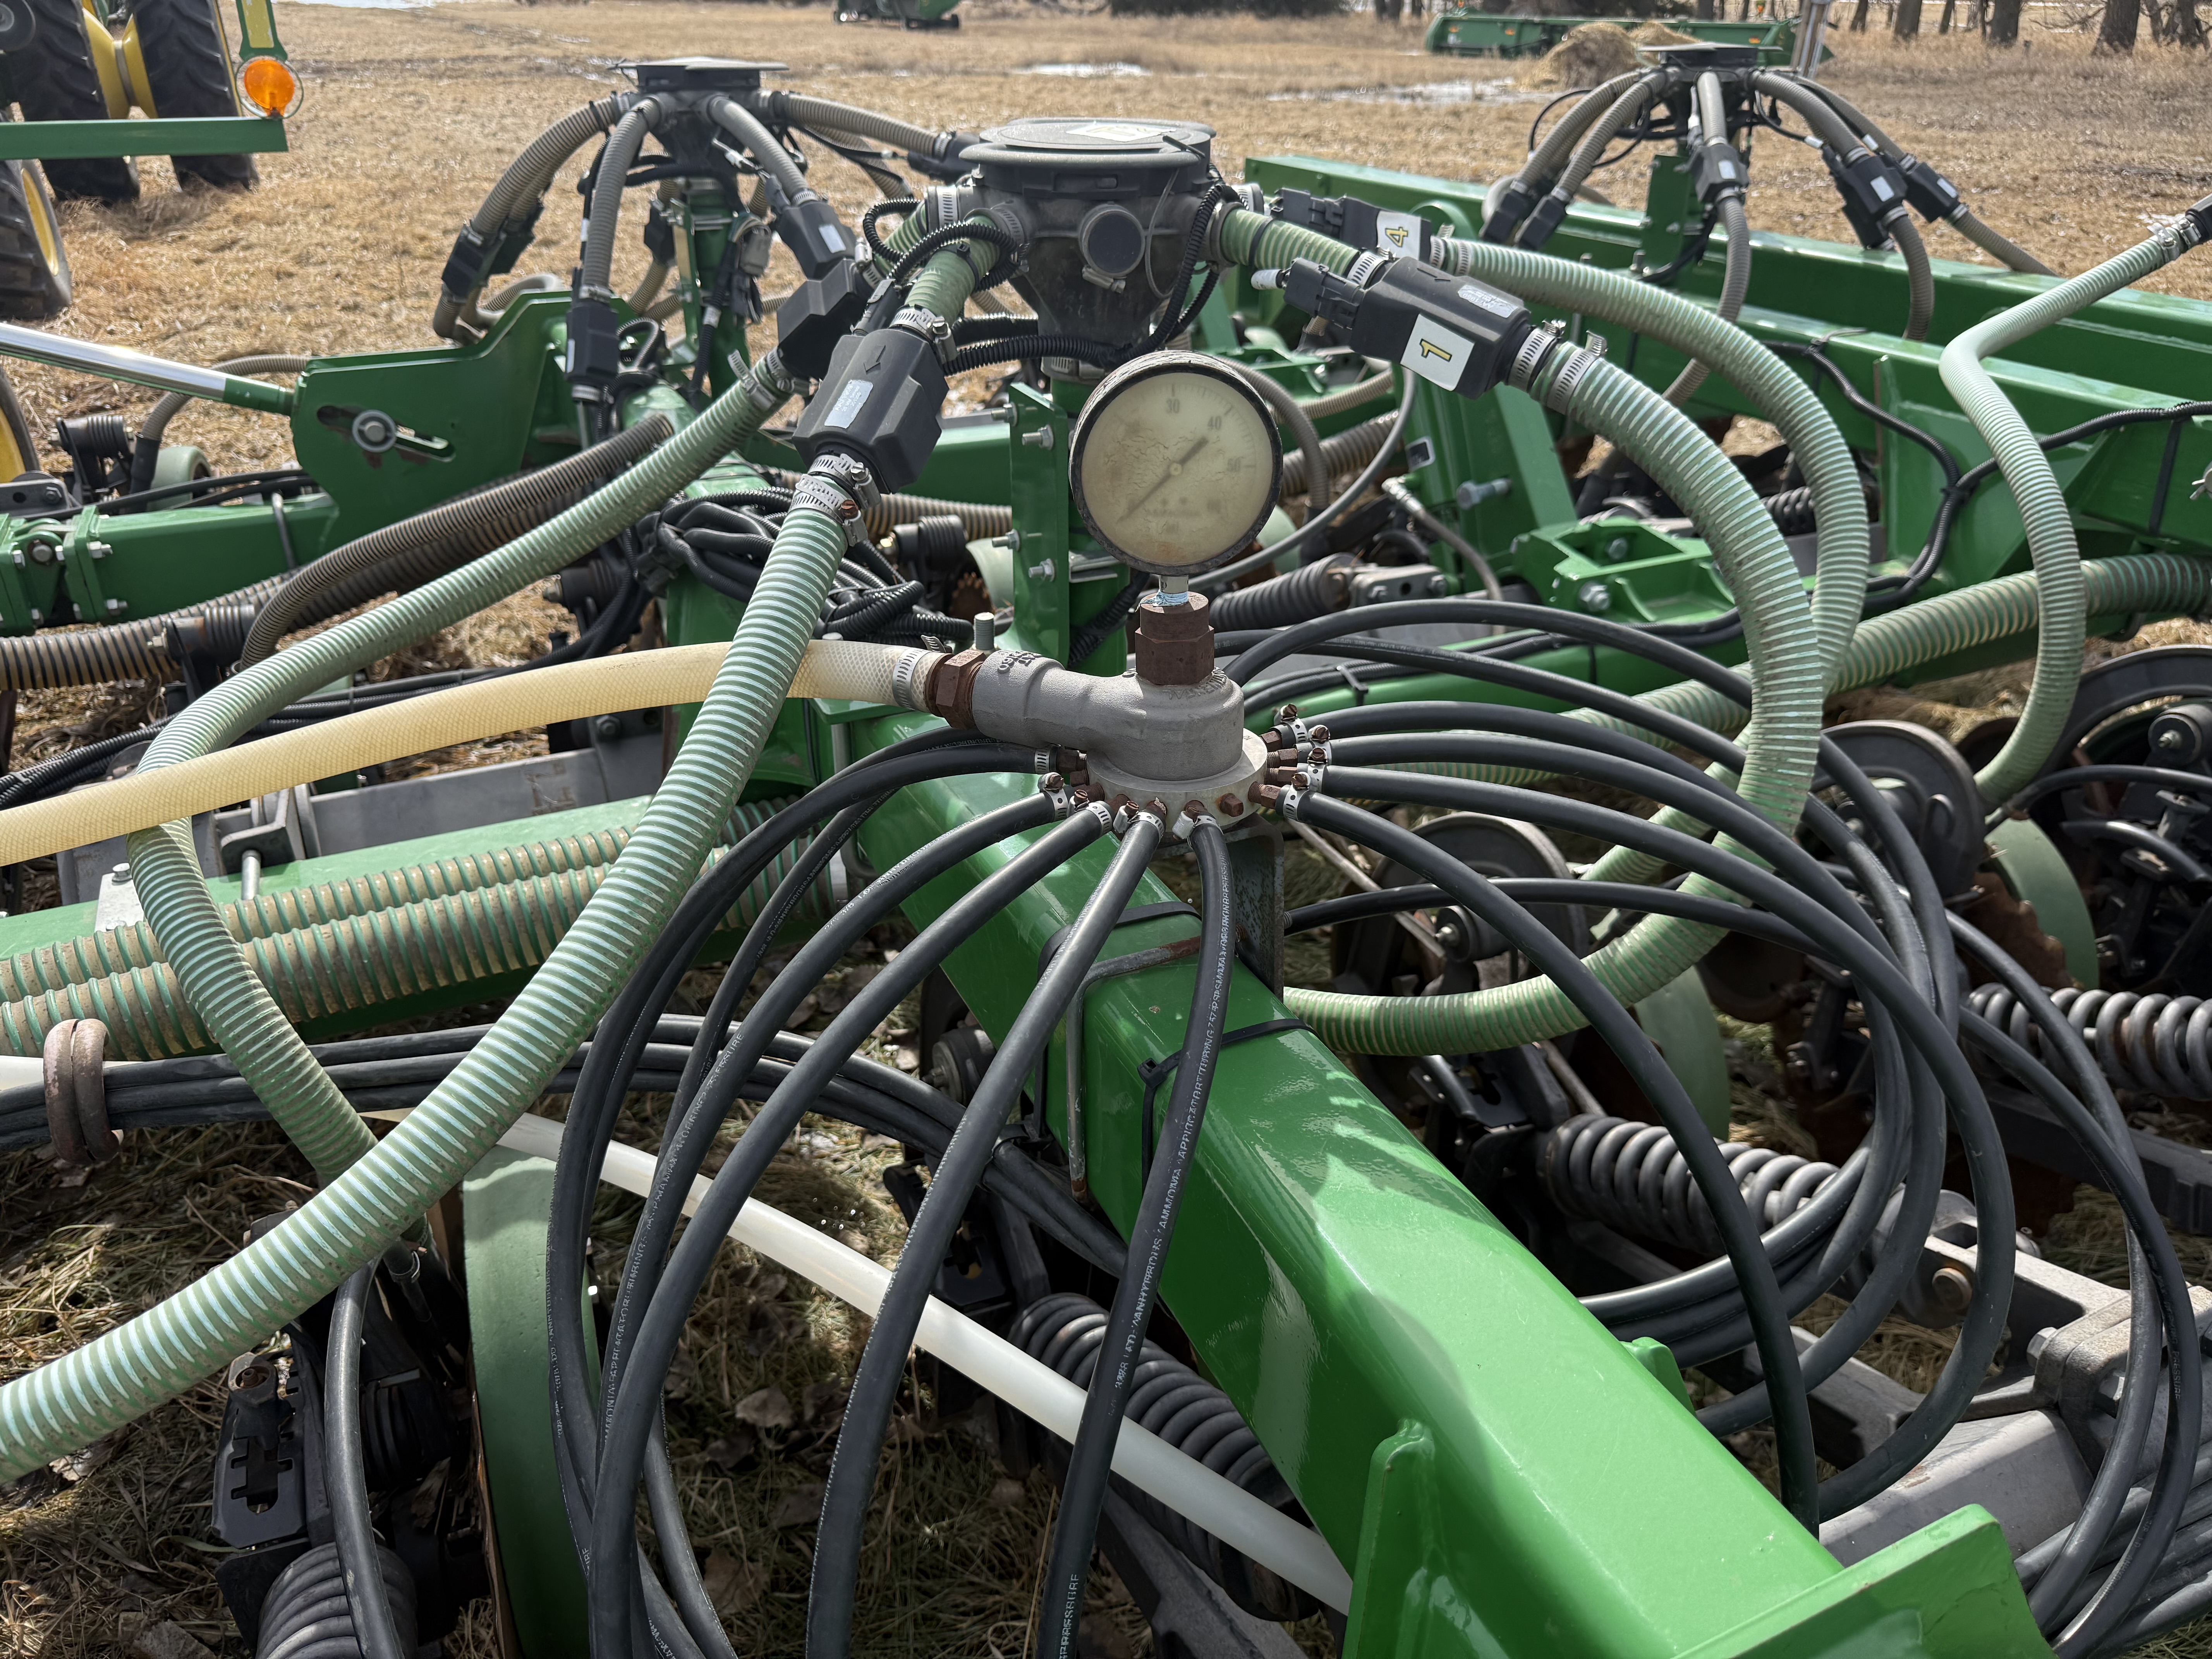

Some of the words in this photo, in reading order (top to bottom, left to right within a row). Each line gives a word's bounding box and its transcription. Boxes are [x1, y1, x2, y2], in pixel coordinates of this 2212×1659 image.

[1385, 227, 1408, 247] 4
[1419, 338, 1452, 362] 1
[1166, 398, 1180, 414] 30
[1207, 416, 1221, 431] 40
